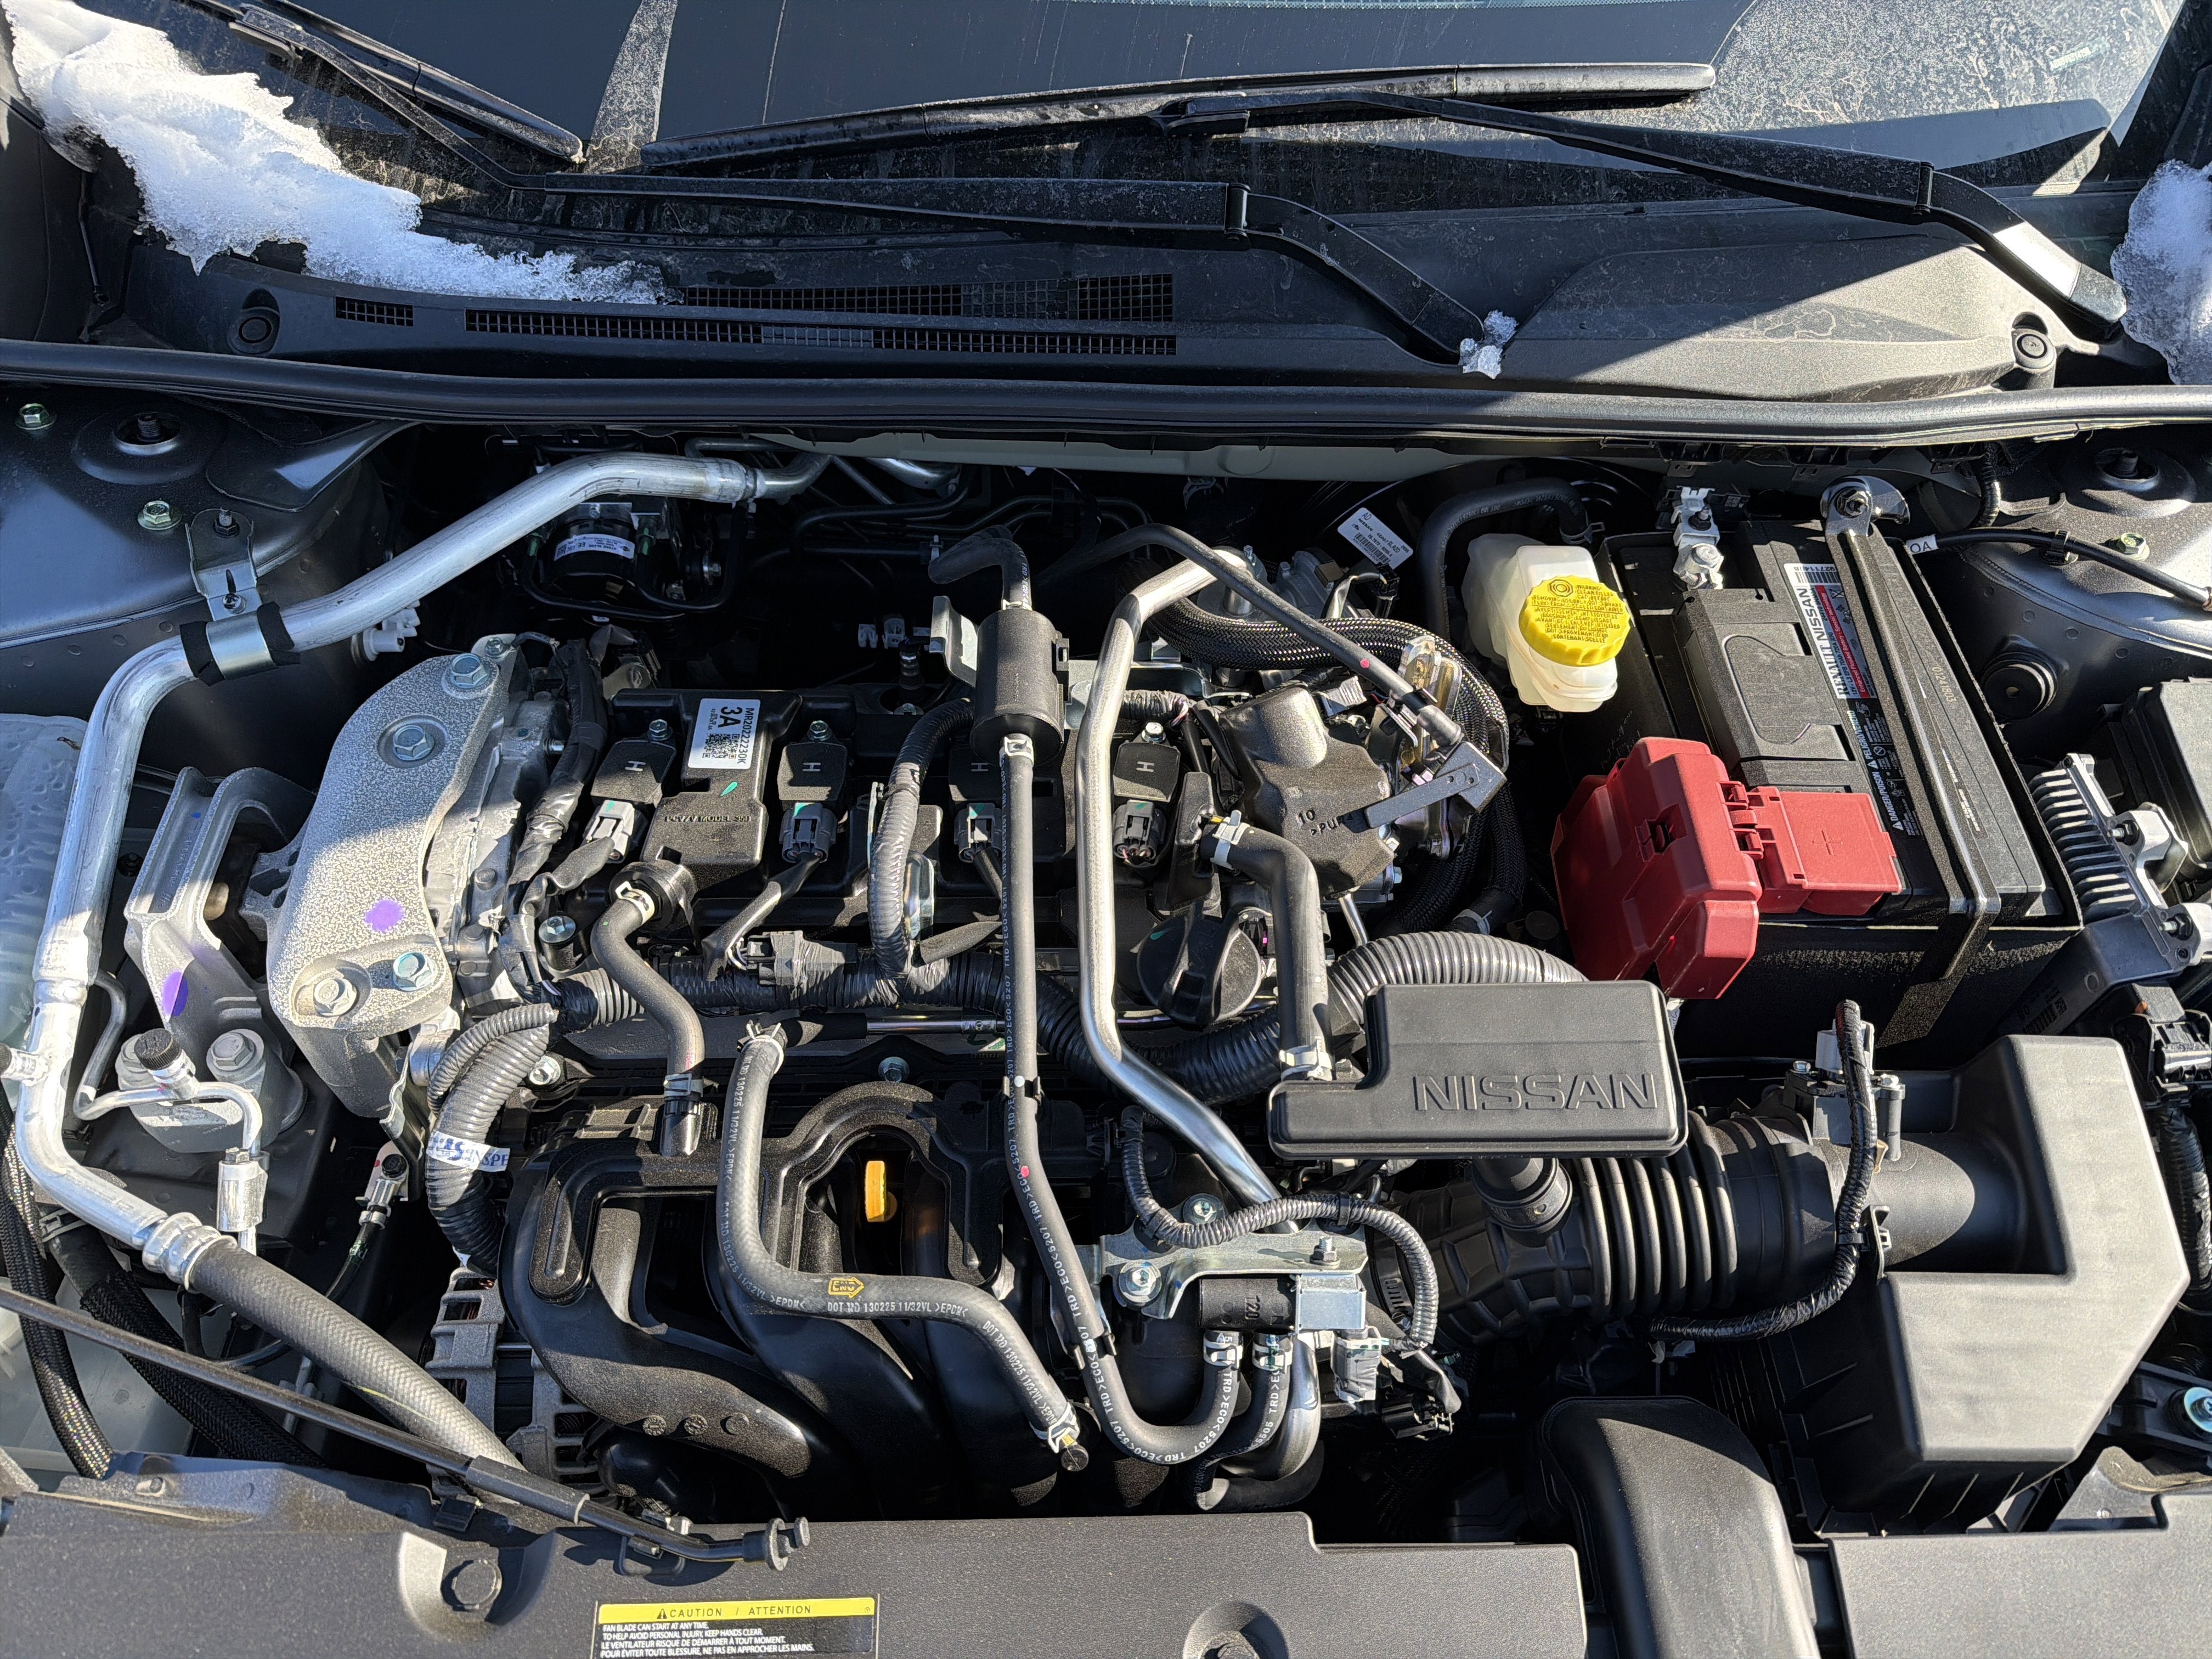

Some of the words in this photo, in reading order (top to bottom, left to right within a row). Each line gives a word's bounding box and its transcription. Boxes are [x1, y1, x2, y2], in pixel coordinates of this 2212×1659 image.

[1796, 588, 1827, 640] NISSAN
[718, 706, 743, 728] 3A
[1871, 771, 1898, 821] DANGER/POISON
[1298, 809, 1316, 824] 10
[1413, 1072, 1659, 1113] NISSAN
[827, 1301, 844, 1312] DOT
[864, 1301, 896, 1312] 130225
[1244, 1295, 1261, 1320] 120
[982, 1320, 999, 1336] DOT
[1003, 1347, 1026, 1376] 130225
[670, 1608, 723, 1618] CAUTION
[748, 1605, 811, 1616] ATTENTION
[617, 1623, 636, 1632] BLADE
[637, 1623, 652, 1631] CAN
[652, 1622, 670, 1631] START
[671, 1622, 679, 1630] AT
[680, 1622, 692, 1630] ANY
[602, 1633, 612, 1641] TO
[613, 1633, 628, 1641] HELP
[629, 1632, 648, 1640] AVOID
[650, 1631, 681, 1639] PERSONAL
[704, 1630, 720, 1638] KEEP
[720, 1629, 741, 1637] HANDS
[600, 1650, 620, 1658] POUR
[622, 1647, 644, 1657] ÉVITER
[645, 1649, 667, 1657] TOUTE
[703, 1646, 713, 1655] NE
[713, 1646, 726, 1655] PAS
[727, 1646, 736, 1654] EN
[737, 1645, 777, 1653] APPROCHER
[778, 1644, 790, 1652] LES
[601, 1641, 610, 1650] LE
[610, 1640, 655, 1649] VENTILATEUR
[656, 1639, 680, 1648] RISQUE
[682, 1639, 691, 1647] DE
[692, 1637, 728, 1646] DÉMARRER
[735, 1637, 753, 1645] TOUT
